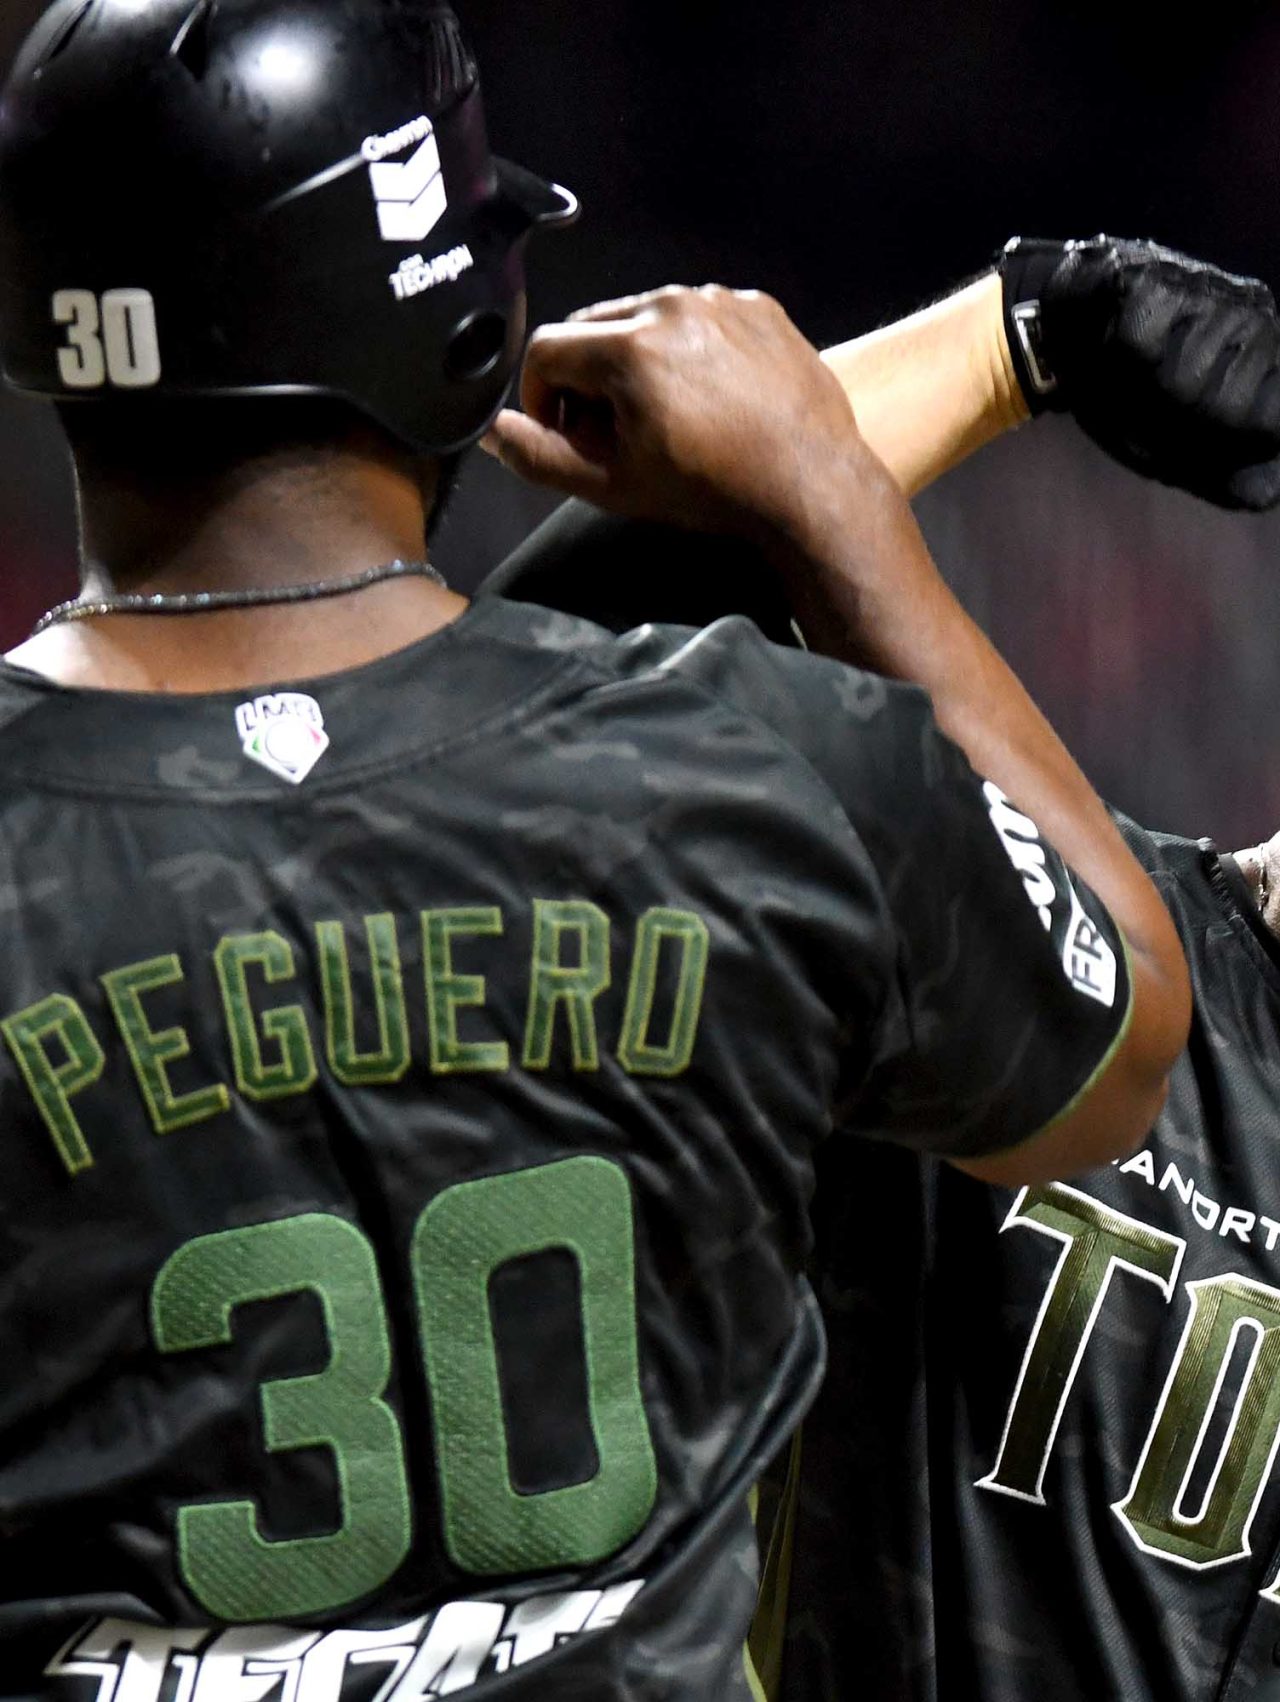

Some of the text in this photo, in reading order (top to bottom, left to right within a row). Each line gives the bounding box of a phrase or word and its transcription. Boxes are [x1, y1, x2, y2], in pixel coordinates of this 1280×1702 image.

[52, 288, 161, 388] 30
[0, 899, 708, 1173] PEGUERO
[151, 1155, 657, 1621] 30
